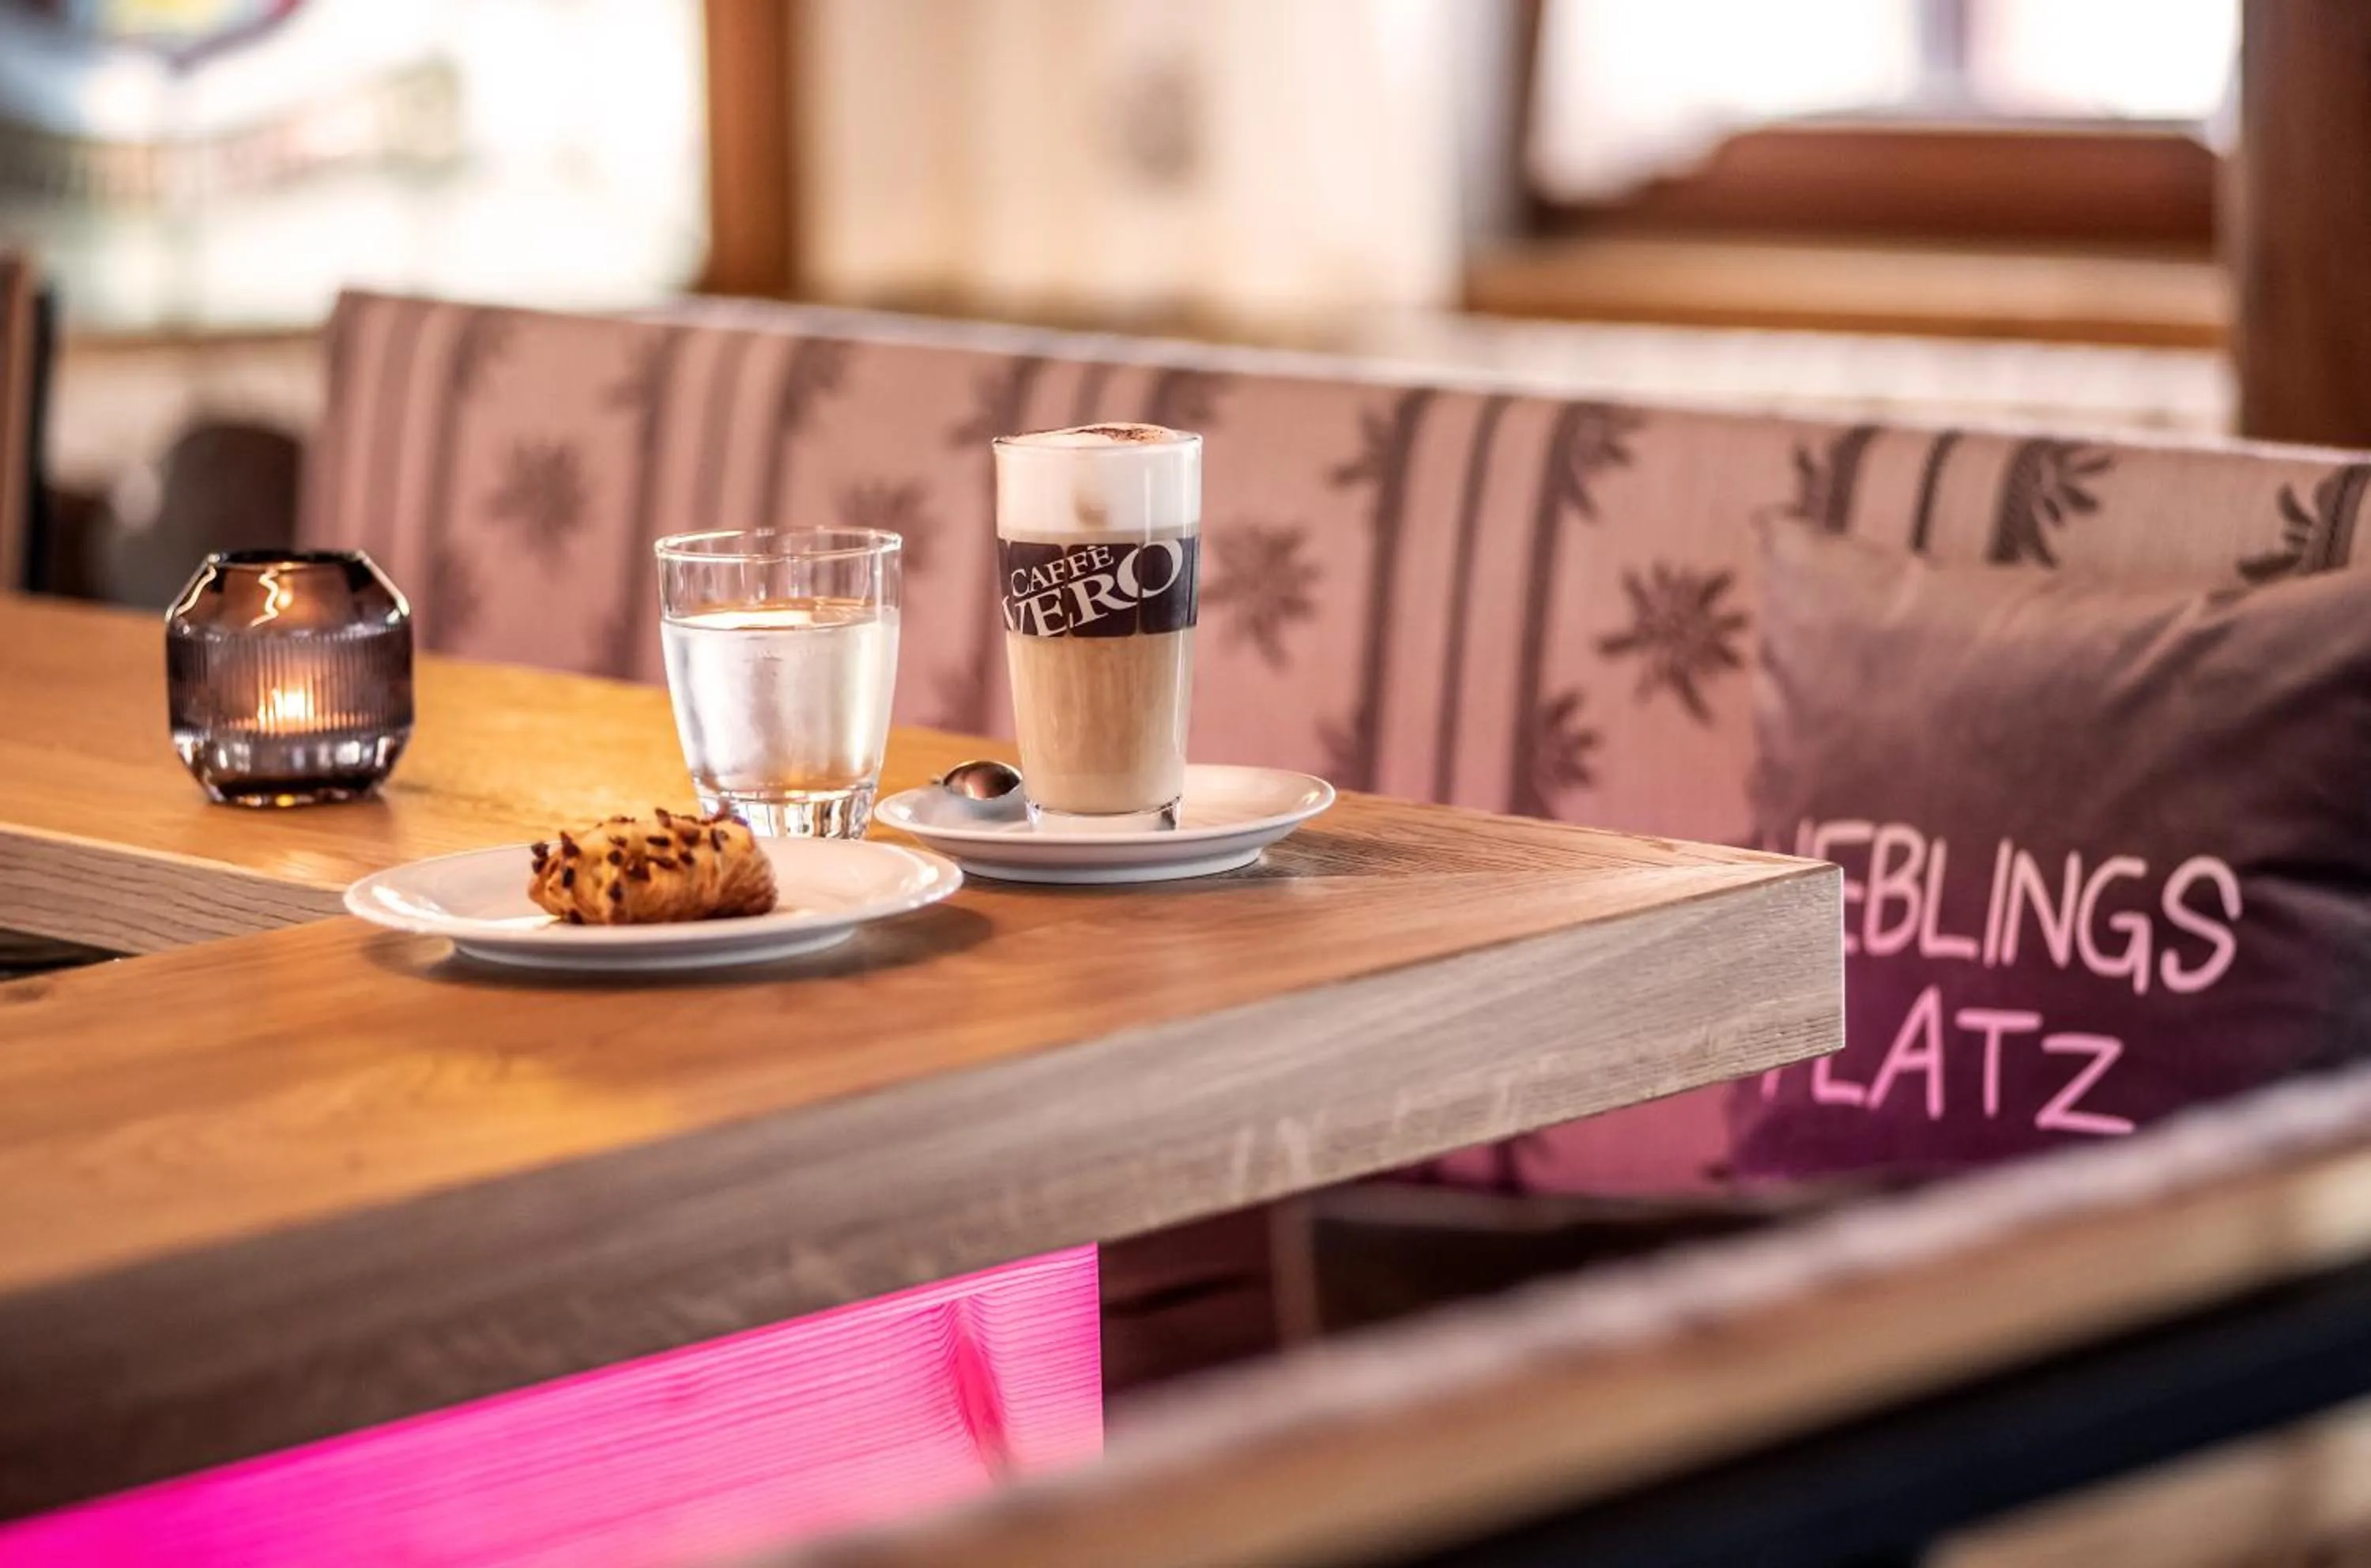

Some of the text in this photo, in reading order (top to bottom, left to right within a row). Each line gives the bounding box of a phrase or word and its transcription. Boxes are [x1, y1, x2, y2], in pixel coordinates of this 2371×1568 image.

[1001, 539, 1183, 637] VERO
[1765, 817, 2242, 994] EBLINGS
[1761, 985, 2134, 1134] LATZ
